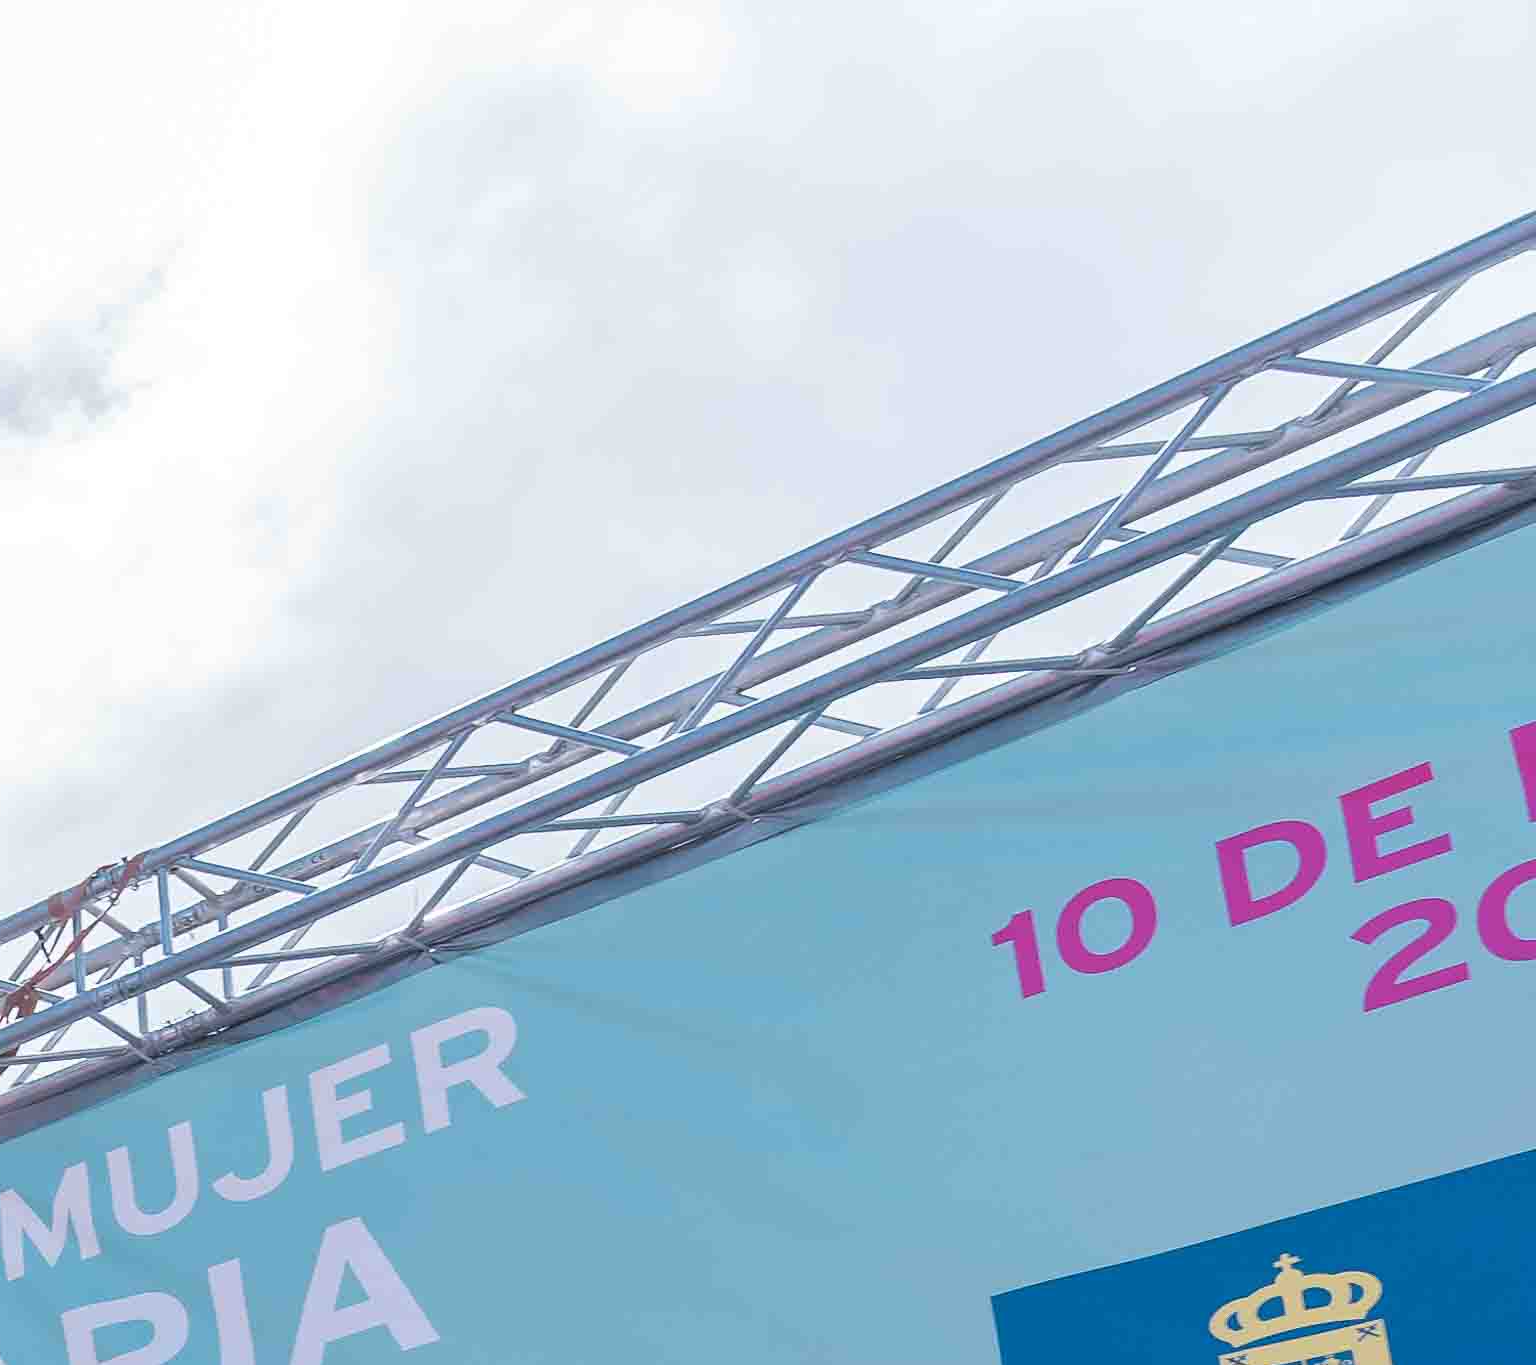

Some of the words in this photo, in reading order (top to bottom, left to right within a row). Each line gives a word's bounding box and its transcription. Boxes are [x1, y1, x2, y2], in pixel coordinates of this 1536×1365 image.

[991, 878, 1158, 999] 10
[1215, 760, 1453, 928] DE
[1349, 860, 1536, 1013] 20
